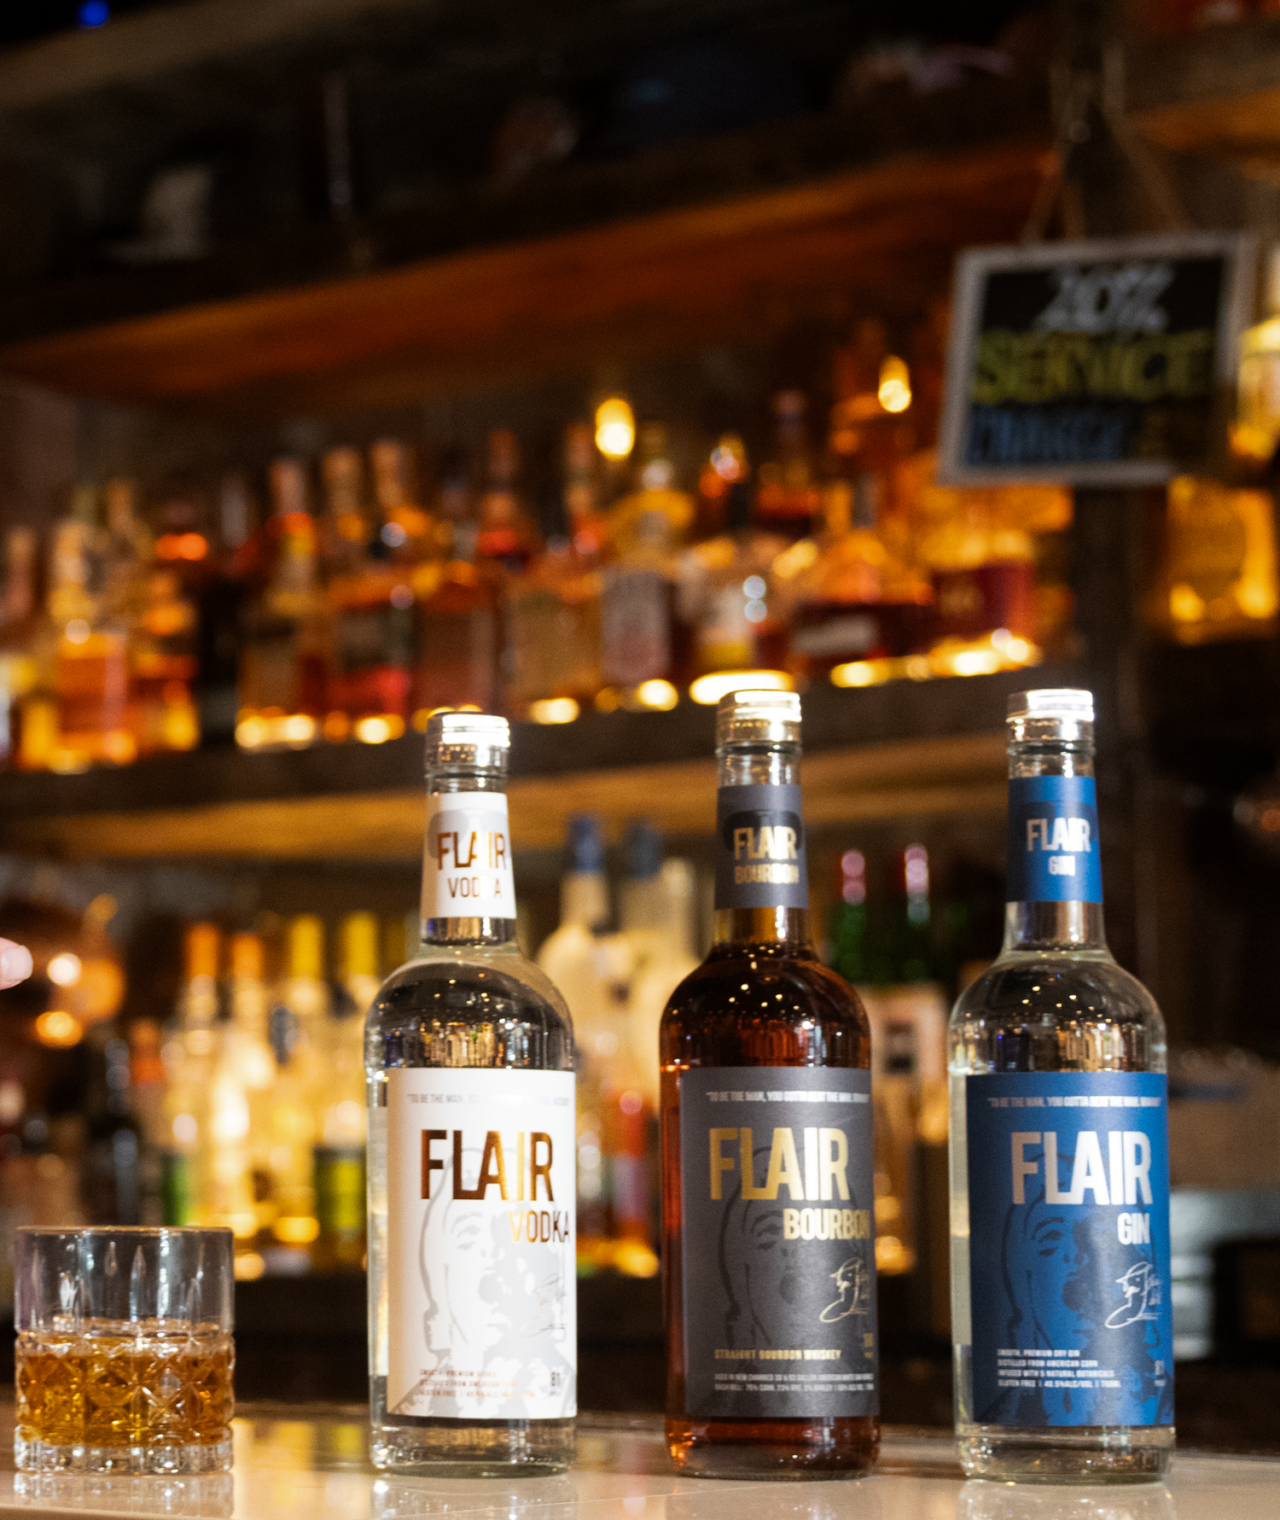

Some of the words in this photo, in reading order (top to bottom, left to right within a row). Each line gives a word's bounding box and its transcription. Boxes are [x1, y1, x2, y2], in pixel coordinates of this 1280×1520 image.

[437, 831, 507, 870] FLAIR
[733, 825, 798, 861] FLAIR
[1027, 817, 1092, 853] FLAIR
[1048, 855, 1076, 877] GIN
[447, 877, 502, 898] VODA
[421, 1129, 554, 1202] FLAIR
[709, 1127, 851, 1201] FLAIR
[1011, 1131, 1153, 1205] FLAIR
[507, 1210, 570, 1243] VODKA
[1117, 1212, 1150, 1245] GIN
